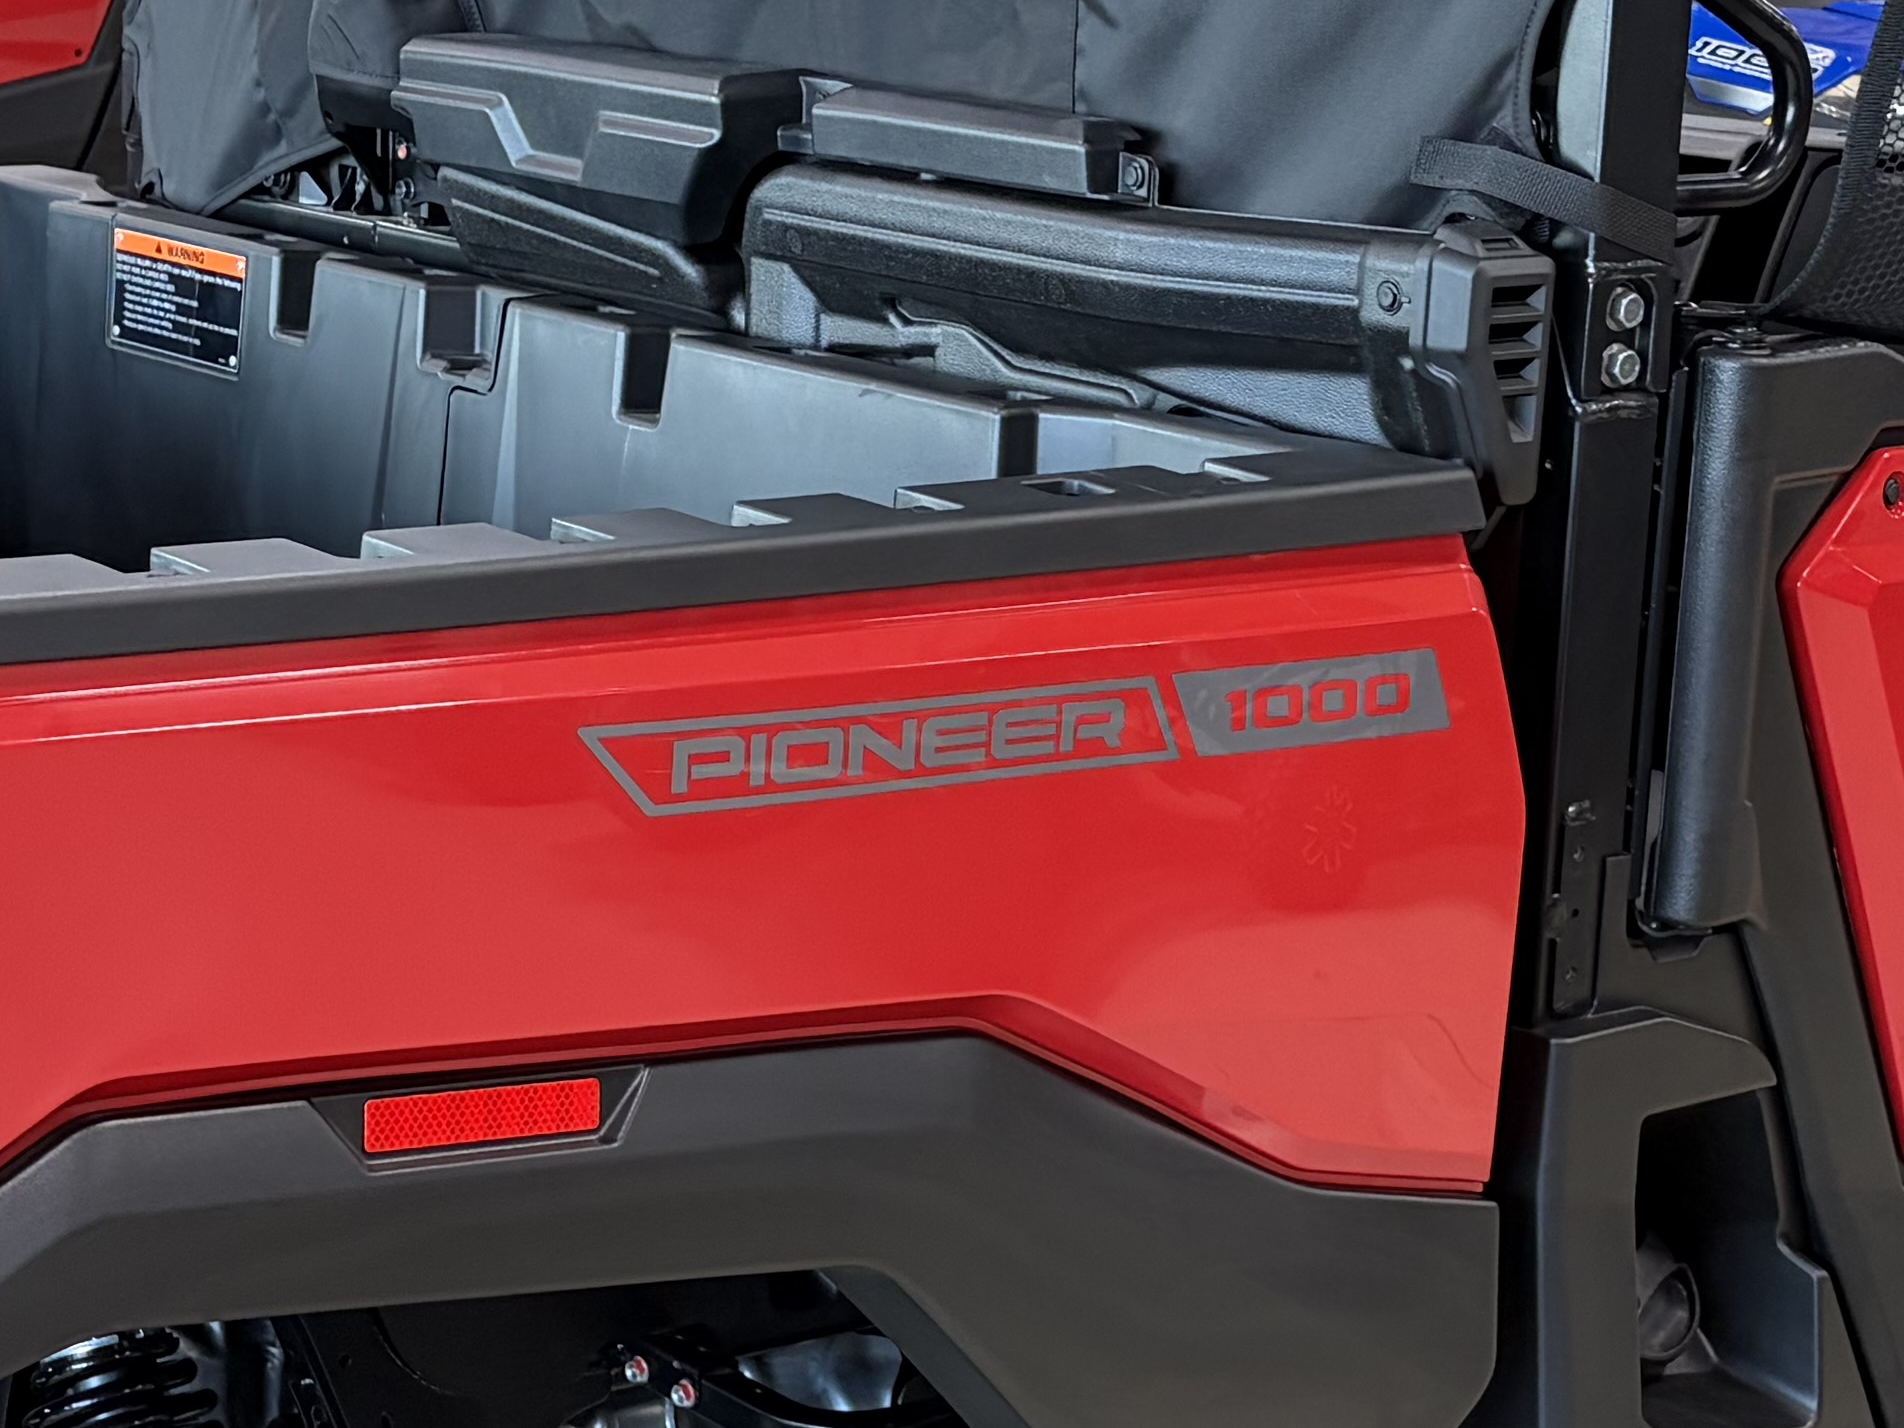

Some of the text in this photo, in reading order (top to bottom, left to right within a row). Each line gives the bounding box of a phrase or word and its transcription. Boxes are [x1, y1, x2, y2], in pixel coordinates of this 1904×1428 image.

[166, 243, 206, 265] WARNING
[670, 672, 1412, 795] PIONEER 1000
